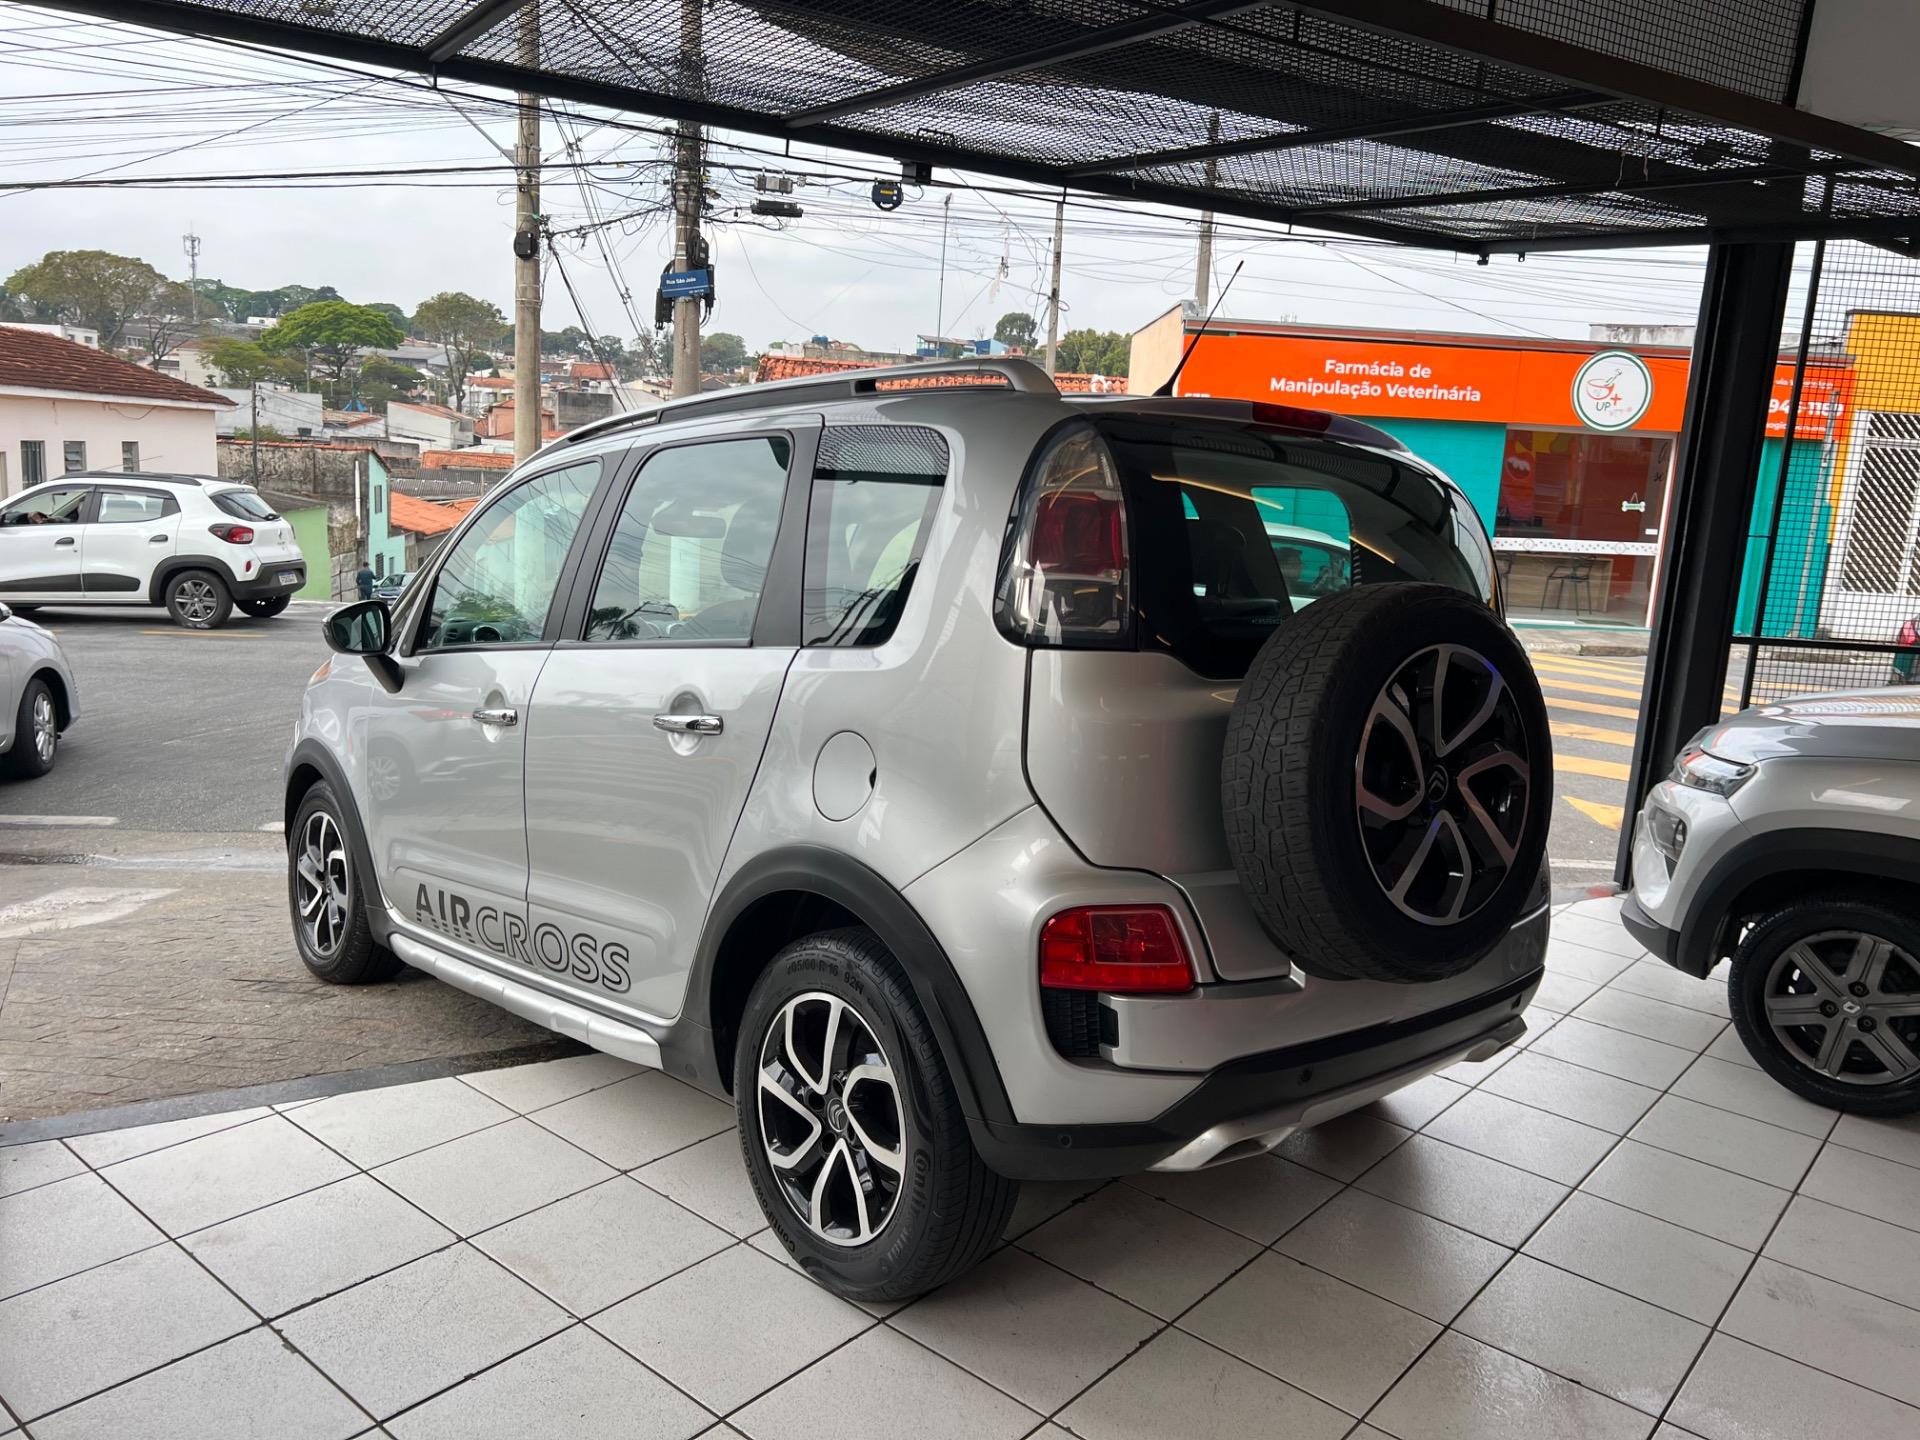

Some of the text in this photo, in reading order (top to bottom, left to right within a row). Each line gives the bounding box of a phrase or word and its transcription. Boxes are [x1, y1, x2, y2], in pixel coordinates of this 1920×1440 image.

[1325, 359, 1432, 378] Farmácia de
[1270, 377, 1481, 402] Manipulação Veterinária
[415, 882, 632, 994] AIRCROSS
